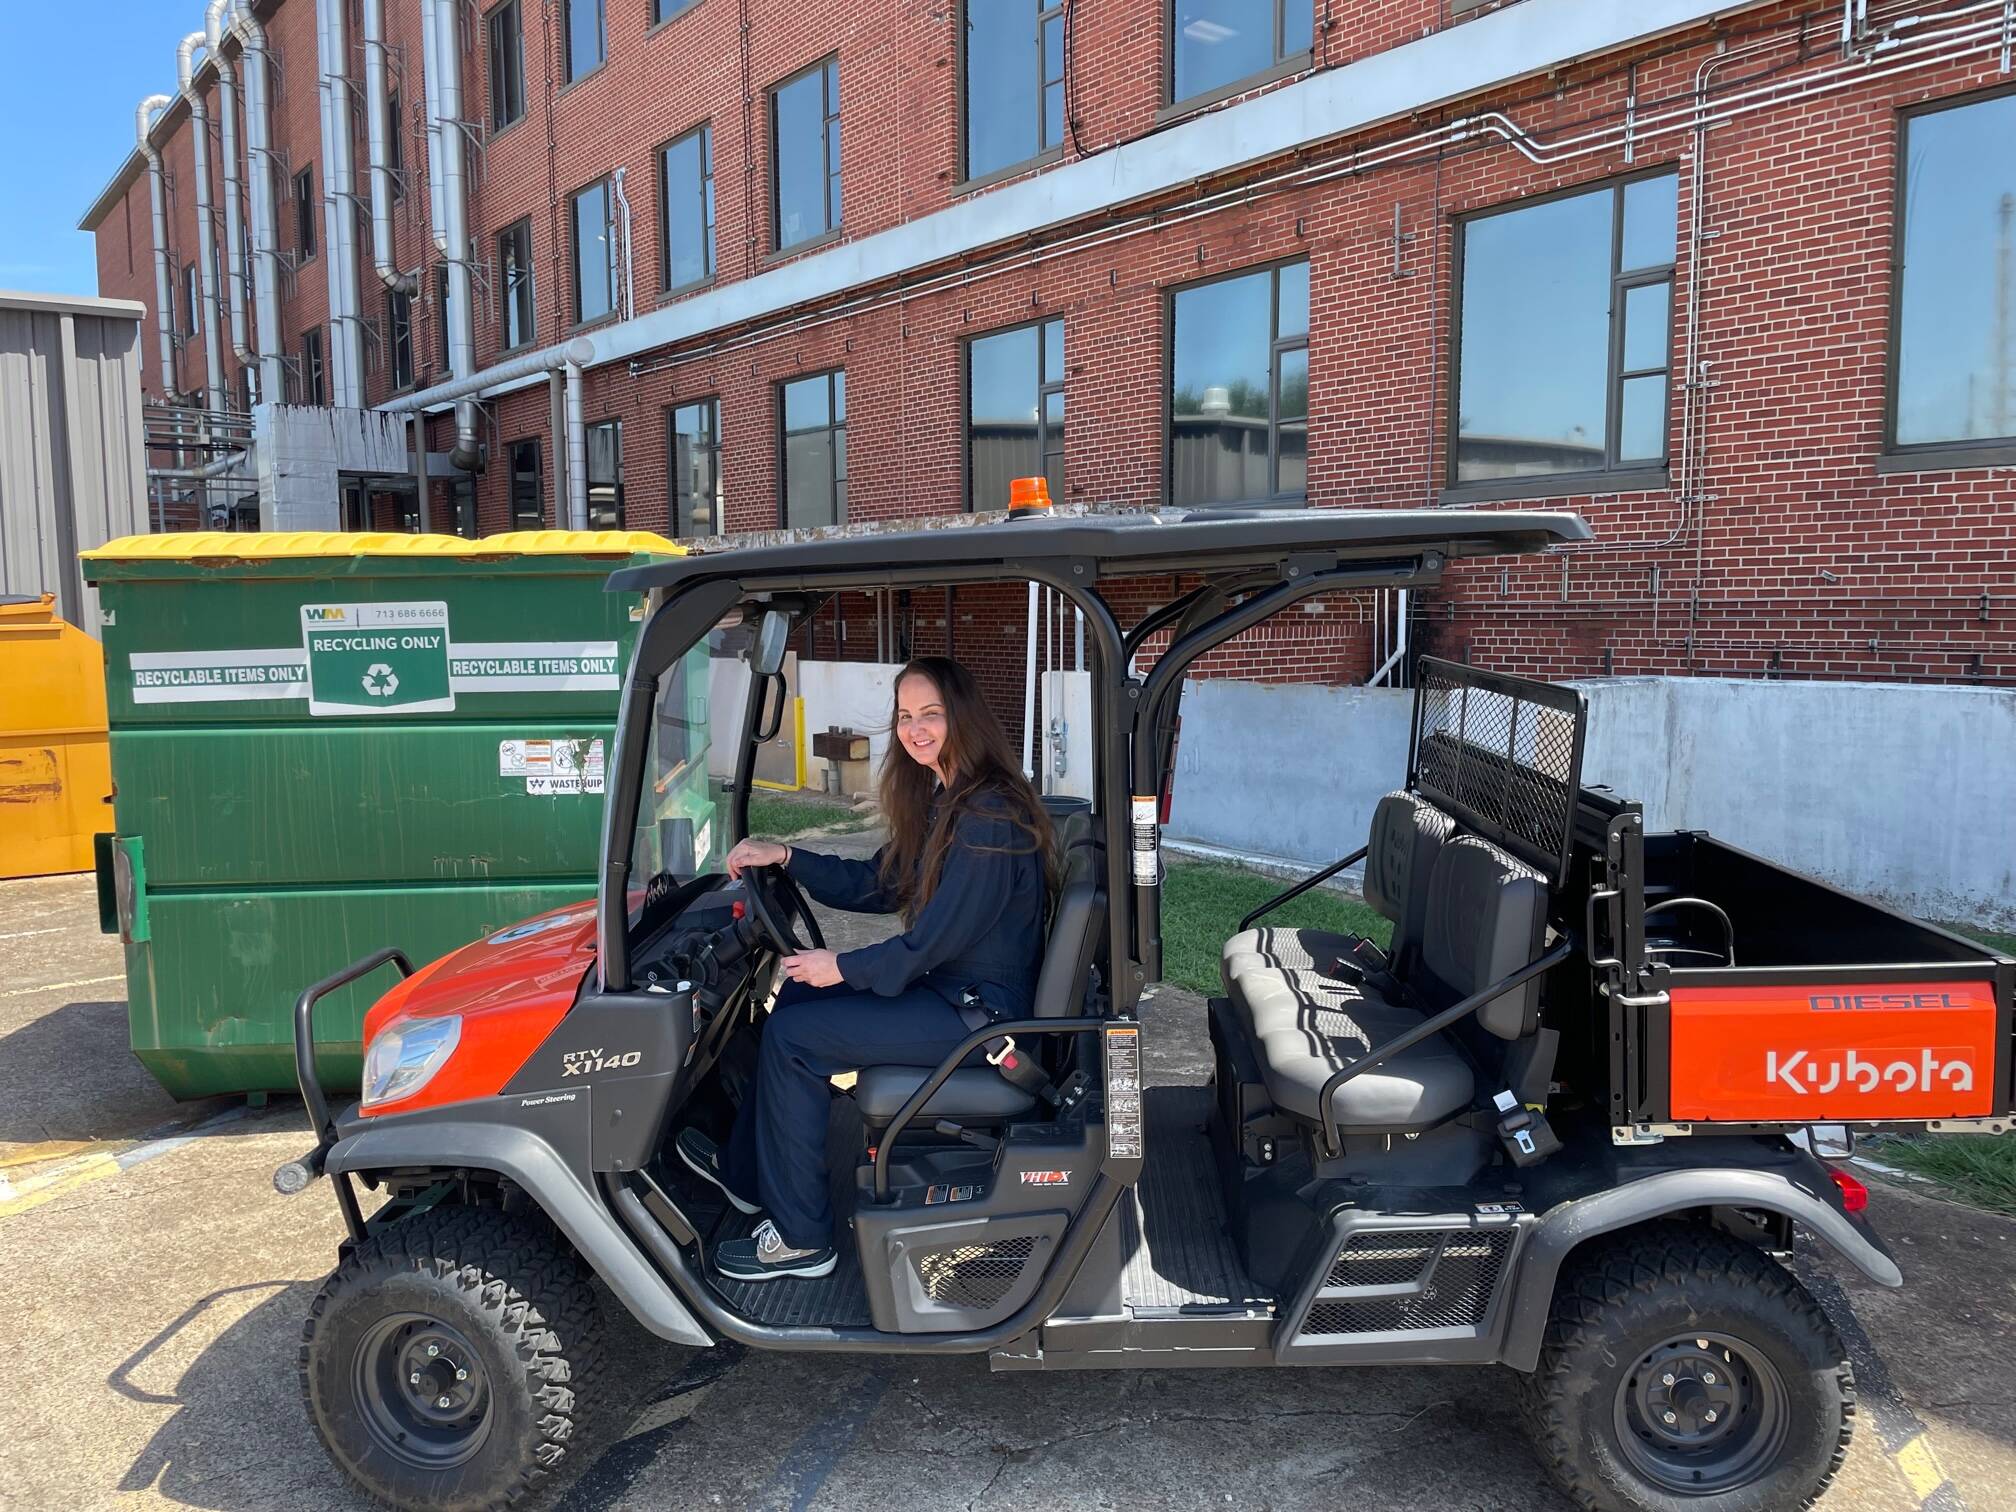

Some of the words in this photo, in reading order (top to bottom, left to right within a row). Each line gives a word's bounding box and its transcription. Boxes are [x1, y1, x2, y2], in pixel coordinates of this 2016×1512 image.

[305, 608, 345, 619] WM
[375, 610, 395, 618] 713
[313, 637, 398, 652] RECYCLING
[401, 636, 440, 649] ONLY
[452, 660, 536, 675] RECYCLABLE
[538, 659, 578, 674] ITEMS
[580, 658, 615, 673] ONLY
[135, 669, 222, 686] RECYCLABLE
[224, 668, 266, 683] ITEMS
[268, 666, 304, 681] ONLY
[1809, 993, 1969, 1011] DIESEL
[563, 1047, 604, 1063] RTV
[561, 1051, 641, 1077] X1140
[1766, 1048, 1974, 1095] Kubota
[521, 1098, 544, 1107] Power
[544, 1093, 576, 1104] Steering
